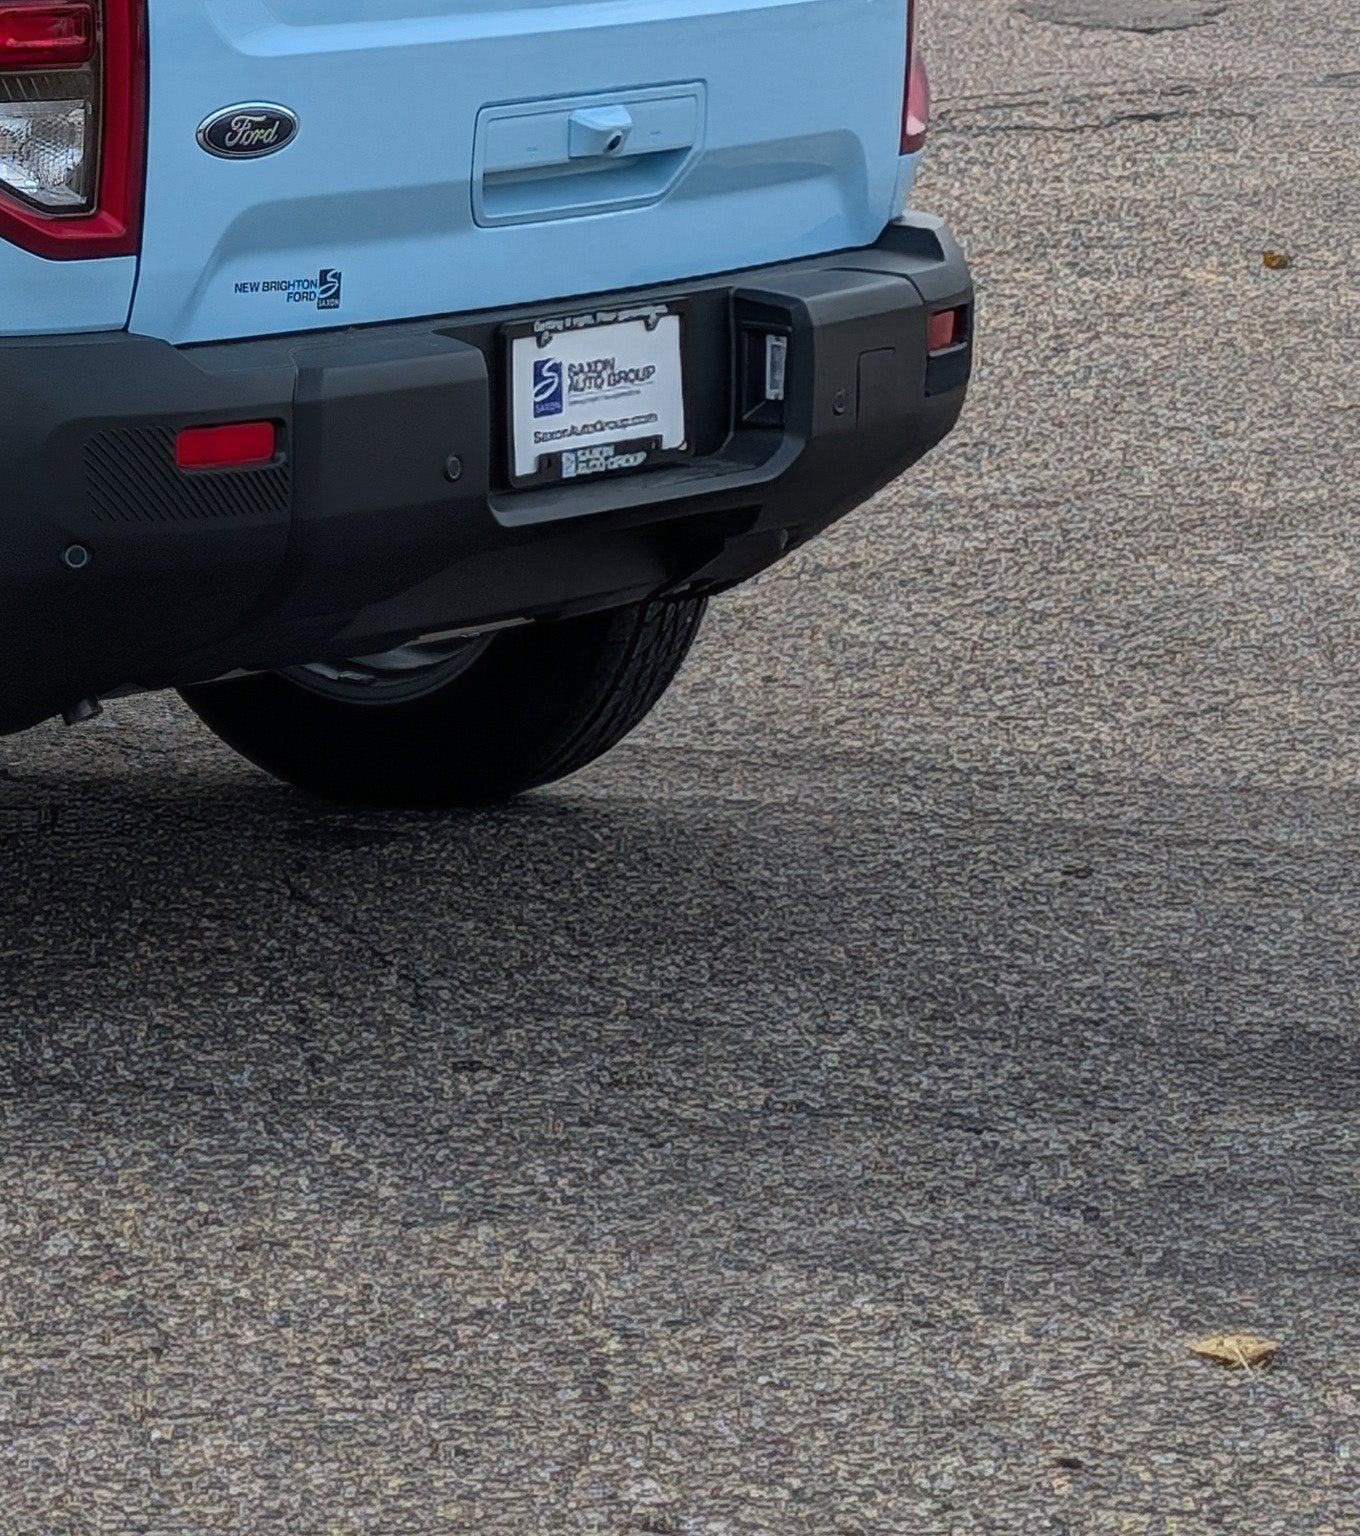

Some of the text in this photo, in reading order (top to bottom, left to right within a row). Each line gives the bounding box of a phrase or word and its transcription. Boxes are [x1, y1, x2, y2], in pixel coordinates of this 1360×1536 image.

[225, 115, 280, 147] Ford
[234, 278, 318, 293] NEW BRIGHTON
[286, 291, 317, 302] FORD
[567, 357, 615, 376] SAXON
[567, 365, 656, 392] AUTO GROUP
